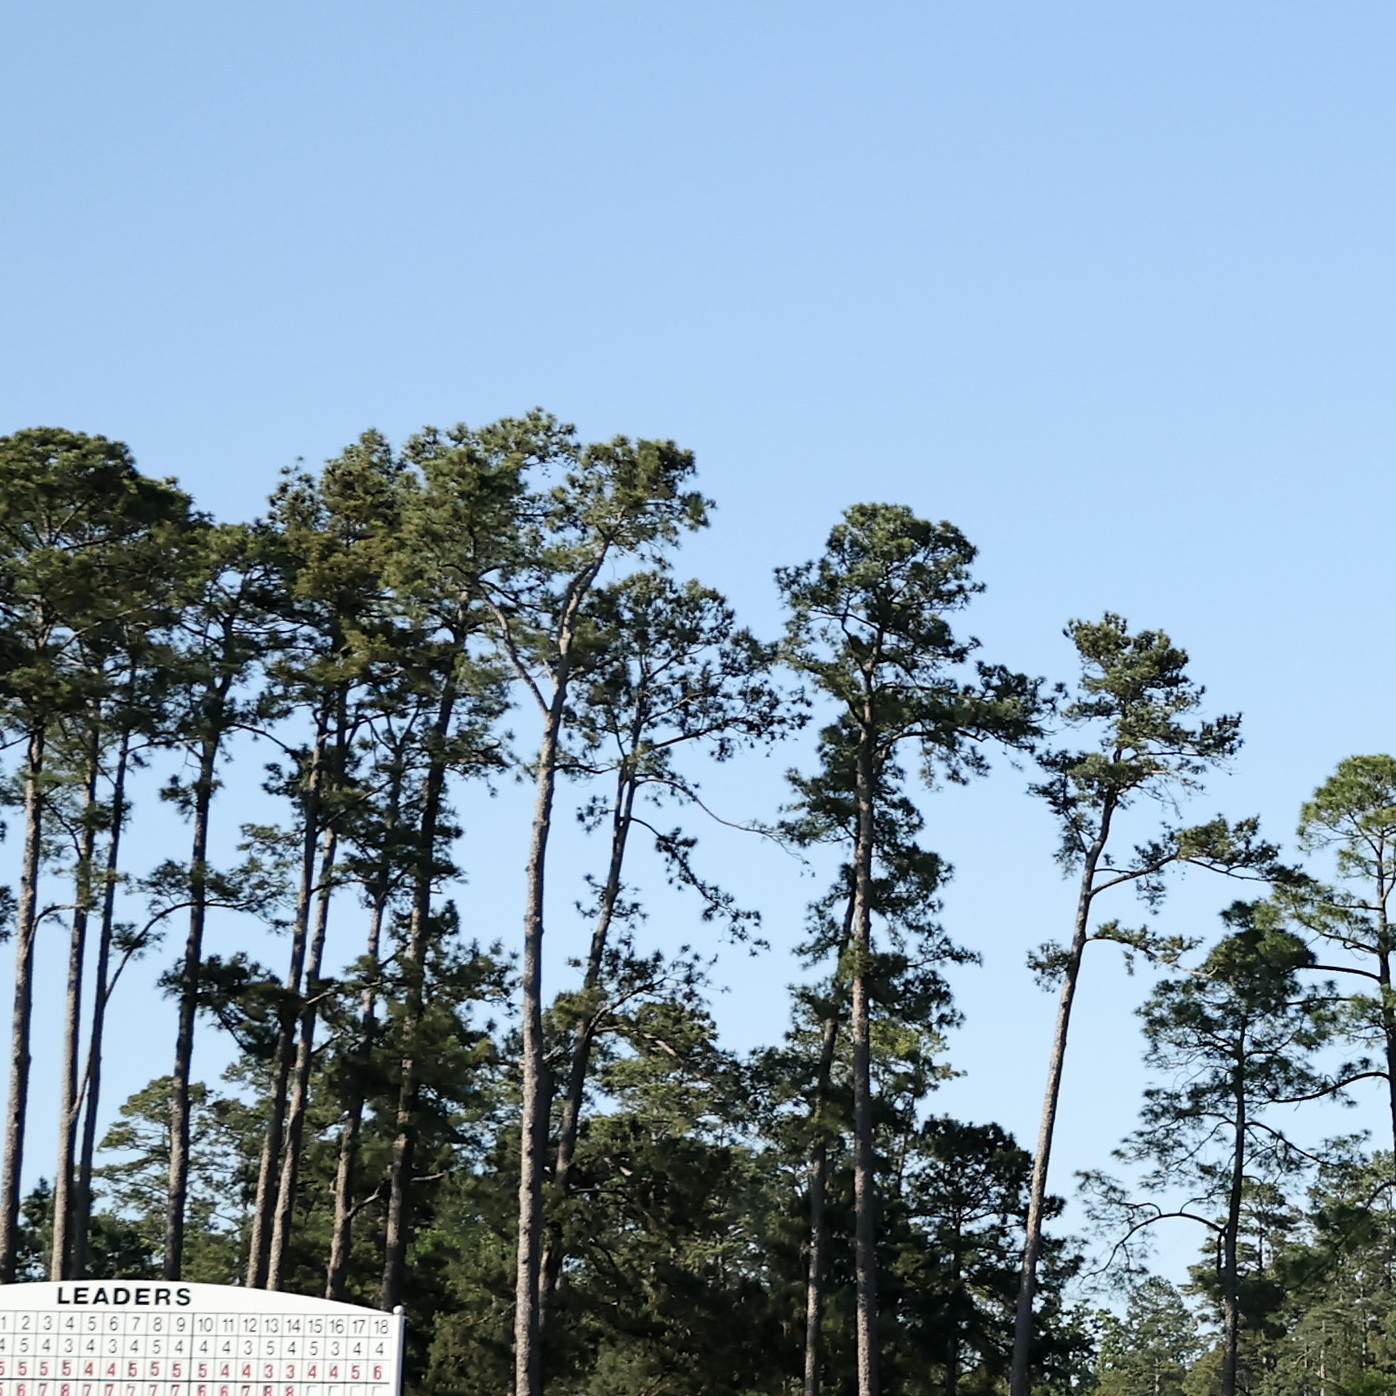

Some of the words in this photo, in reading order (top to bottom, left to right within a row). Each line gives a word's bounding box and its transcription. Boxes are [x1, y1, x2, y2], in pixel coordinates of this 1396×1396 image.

[57, 1287, 191, 1306] LEADERS
[22, 1315, 29, 1330] 2
[44, 1316, 52, 1330] 3
[66, 1317, 74, 1330] 4
[88, 1316, 96, 1331] 5
[110, 1316, 118, 1331] 6
[133, 1317, 140, 1331] 7
[153, 1317, 162, 1332] 8
[177, 1317, 185, 1332] 9
[199, 1318, 213, 1332] 10
[223, 1319, 233, 1331] 11
[244, 1318, 256, 1332] 12
[265, 1318, 278, 1333] 13
[287, 1319, 300, 1332] 14
[309, 1319, 322, 1333] 15
[330, 1319, 344, 1334] 16
[353, 1320, 365, 1333] 17
[375, 1320, 388, 1334] 18
[21, 1338, 28, 1352] 5
[42, 1339, 50, 1352] 4
[65, 1338, 73, 1353] 3
[87, 1339, 94, 1352] 4
[109, 1339, 117, 1353] 3
[130, 1340, 138, 1353] 4
[153, 1340, 160, 1354] 5
[175, 1340, 183, 1354] 4
[200, 1341, 207, 1354] 4
[223, 1341, 230, 1354] 4
[244, 1340, 252, 1355] 3
[267, 1341, 274, 1355] 5
[288, 1342, 296, 1355] 4
[310, 1341, 318, 1356] 5
[331, 1341, 339, 1356] 3
[354, 1342, 361, 1355] 4
[376, 1343, 383, 1356] 4
[18, 1362, 27, 1376] 5
[39, 1360, 49, 1377] 5
[62, 1361, 72, 1377] 5
[85, 1362, 93, 1376] 4
[107, 1363, 117, 1377] 4
[150, 1361, 160, 1376] 5
[173, 1363, 181, 1378] 5
[199, 1363, 208, 1378] 5
[221, 1364, 230, 1377] 4
[243, 1364, 251, 1378] 4
[265, 1364, 274, 1378] 3
[286, 1364, 295, 1379] 3
[309, 1365, 317, 1378] 4
[329, 1366, 339, 1379] 4
[352, 1365, 360, 1380] 5
[373, 1365, 383, 1380] 6
[39, 1384, 48, 1396] 7
